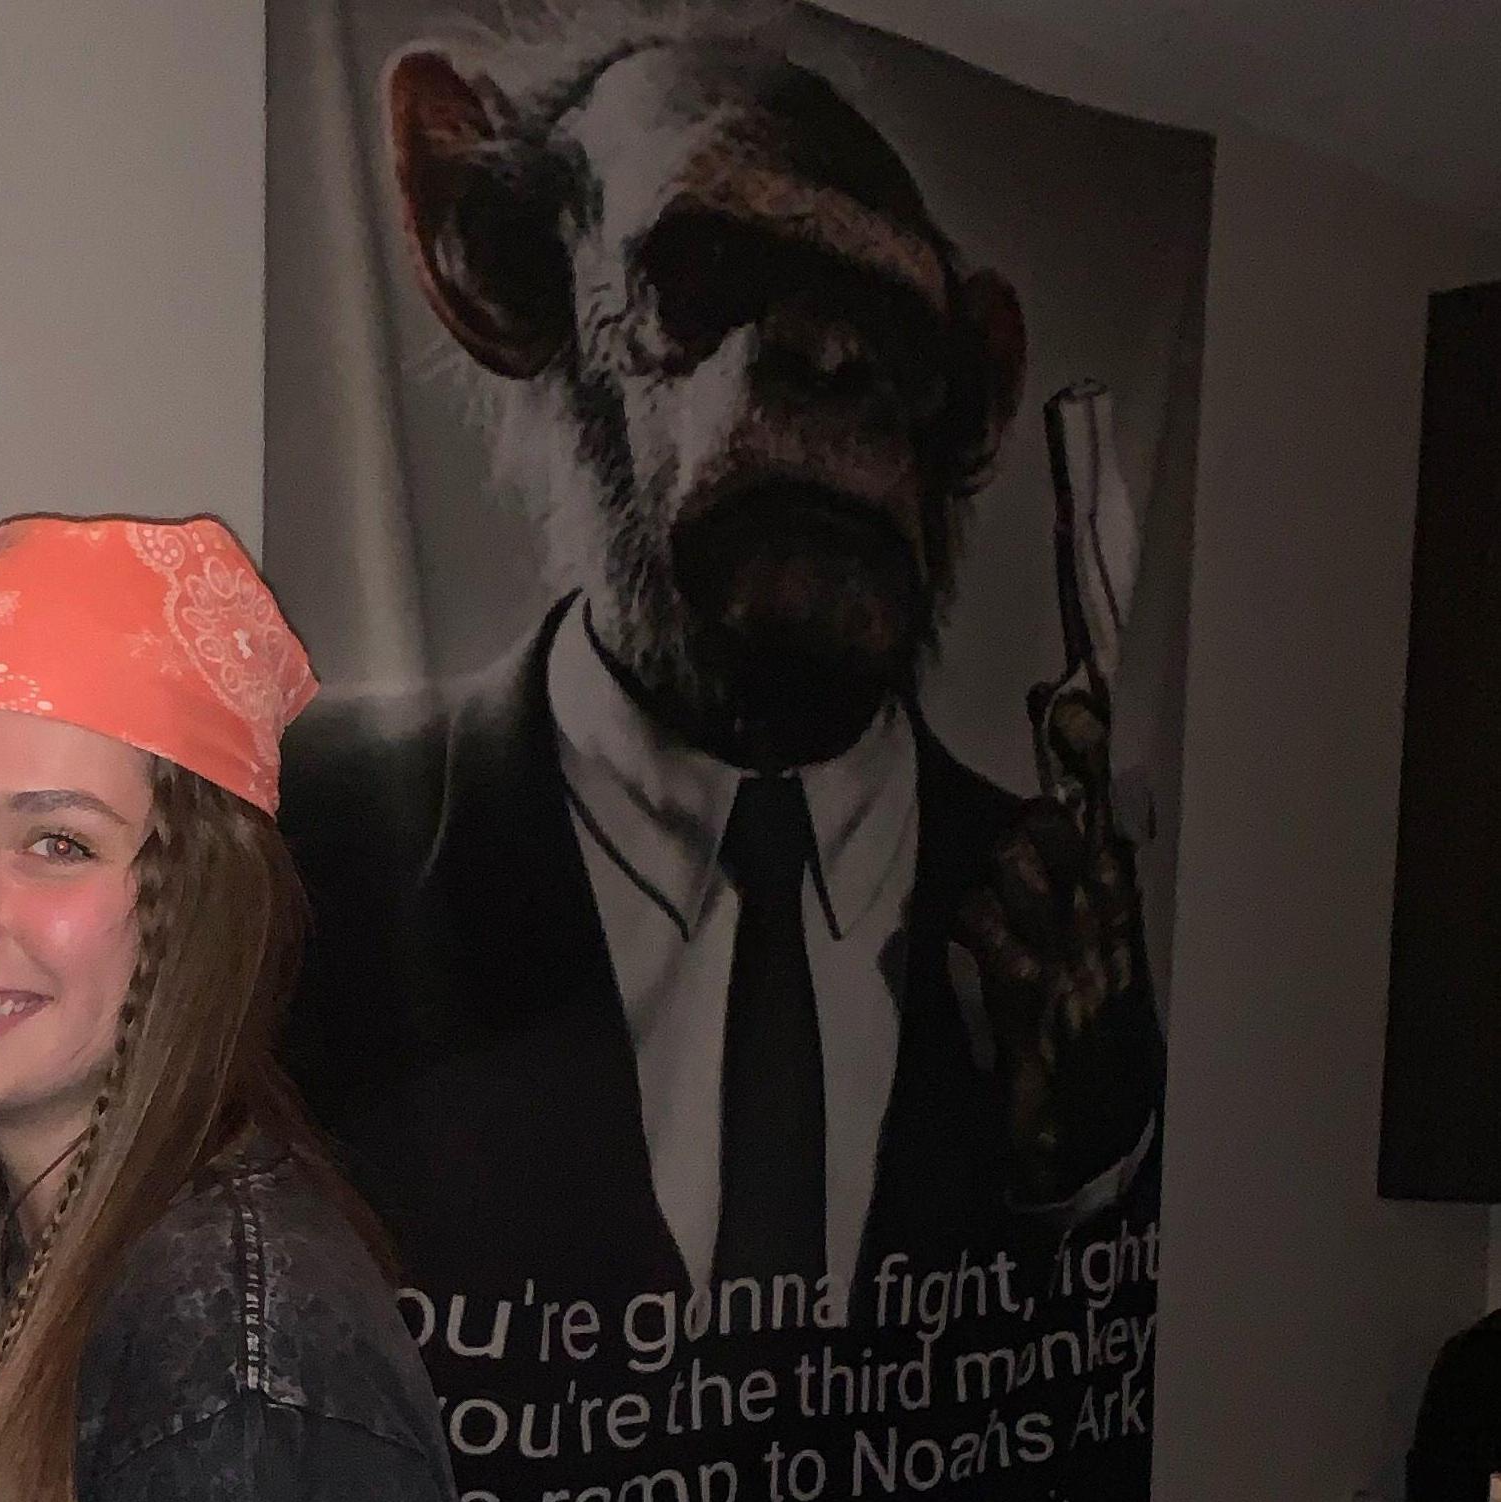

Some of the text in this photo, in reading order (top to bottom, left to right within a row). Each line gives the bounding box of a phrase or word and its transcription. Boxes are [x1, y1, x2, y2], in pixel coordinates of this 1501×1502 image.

[397, 1278, 600, 1361] ou're
[624, 1273, 848, 1372] gonna
[874, 1249, 1035, 1342] fight,
[438, 1305, 1156, 1458] ou're the third monkey
[1070, 1377, 1147, 1449] Ark
